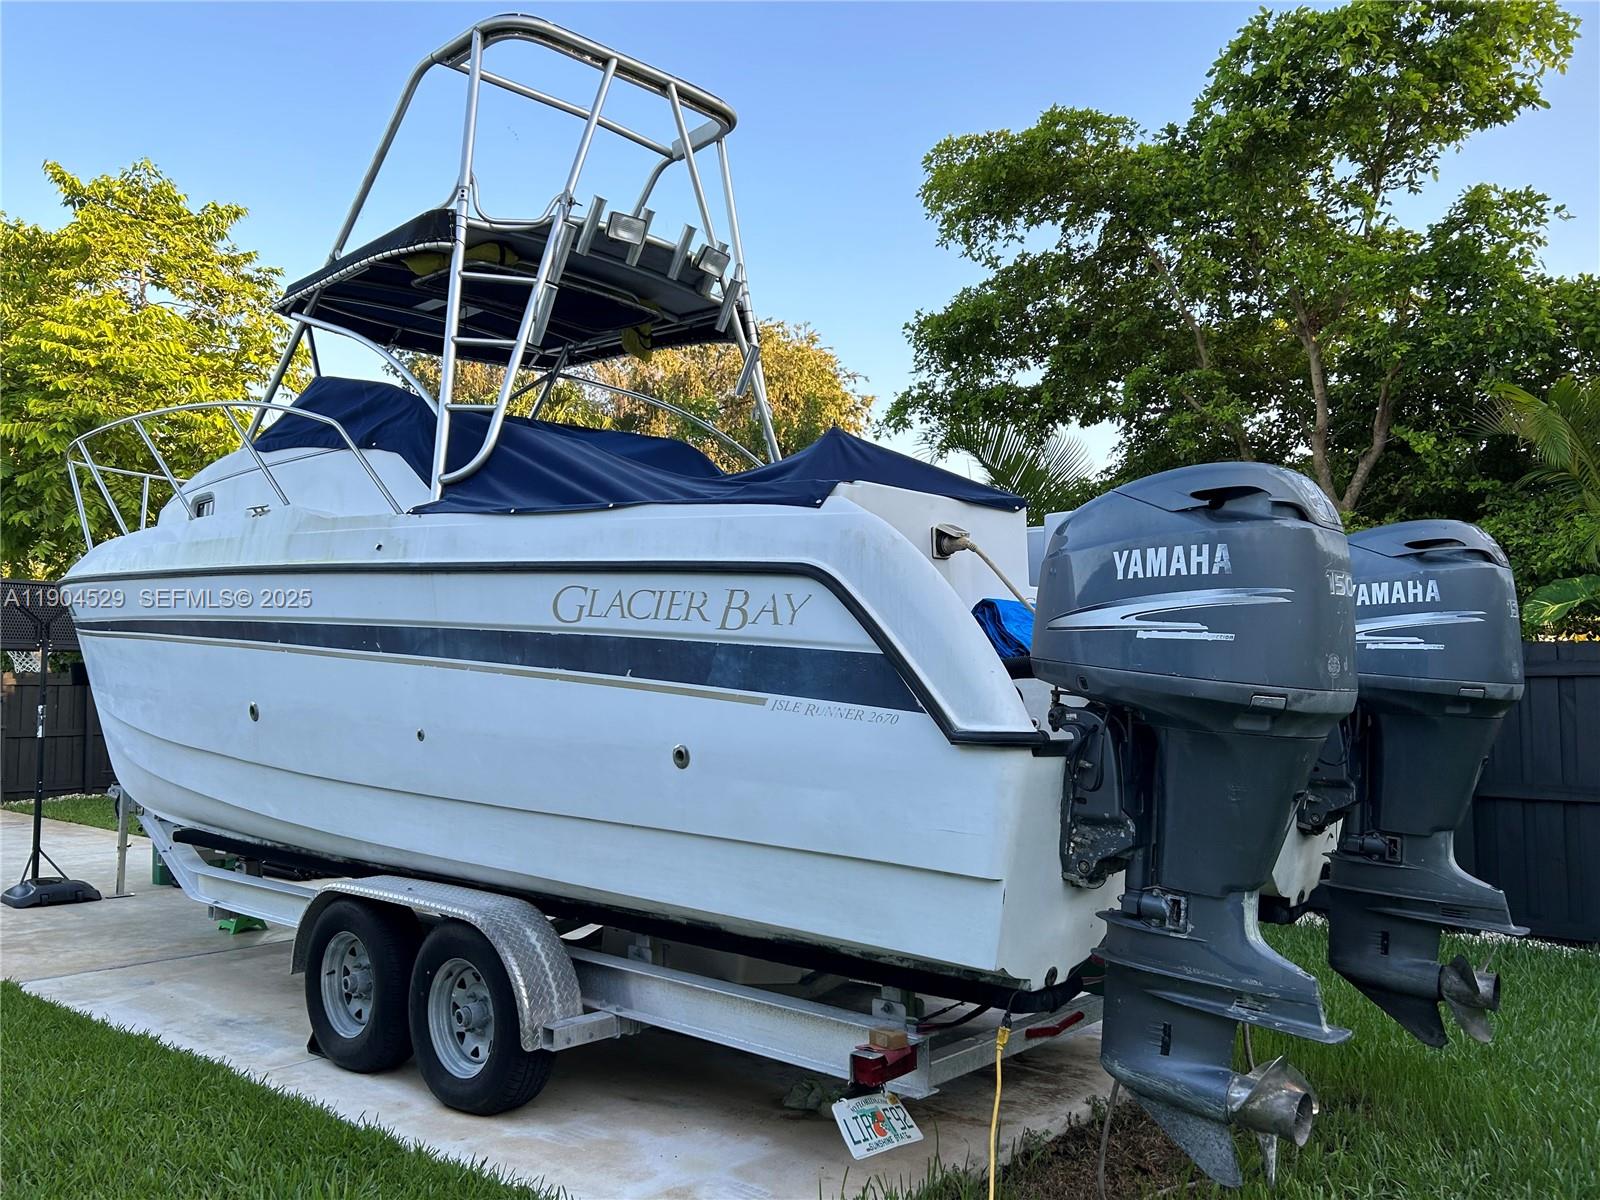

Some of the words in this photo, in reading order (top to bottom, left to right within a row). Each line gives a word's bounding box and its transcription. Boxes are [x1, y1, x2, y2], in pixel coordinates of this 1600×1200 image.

[1113, 543, 1233, 581] YAMAHA
[1327, 570, 1354, 597] 150
[552, 584, 711, 624] GLACIER
[715, 588, 812, 631] BAY
[770, 699, 801, 713] ISLE
[803, 703, 865, 721] RUNNER
[867, 711, 900, 725] 2670
[882, 1105, 914, 1135] F92
[868, 1135, 895, 1151] SUNSHINE
